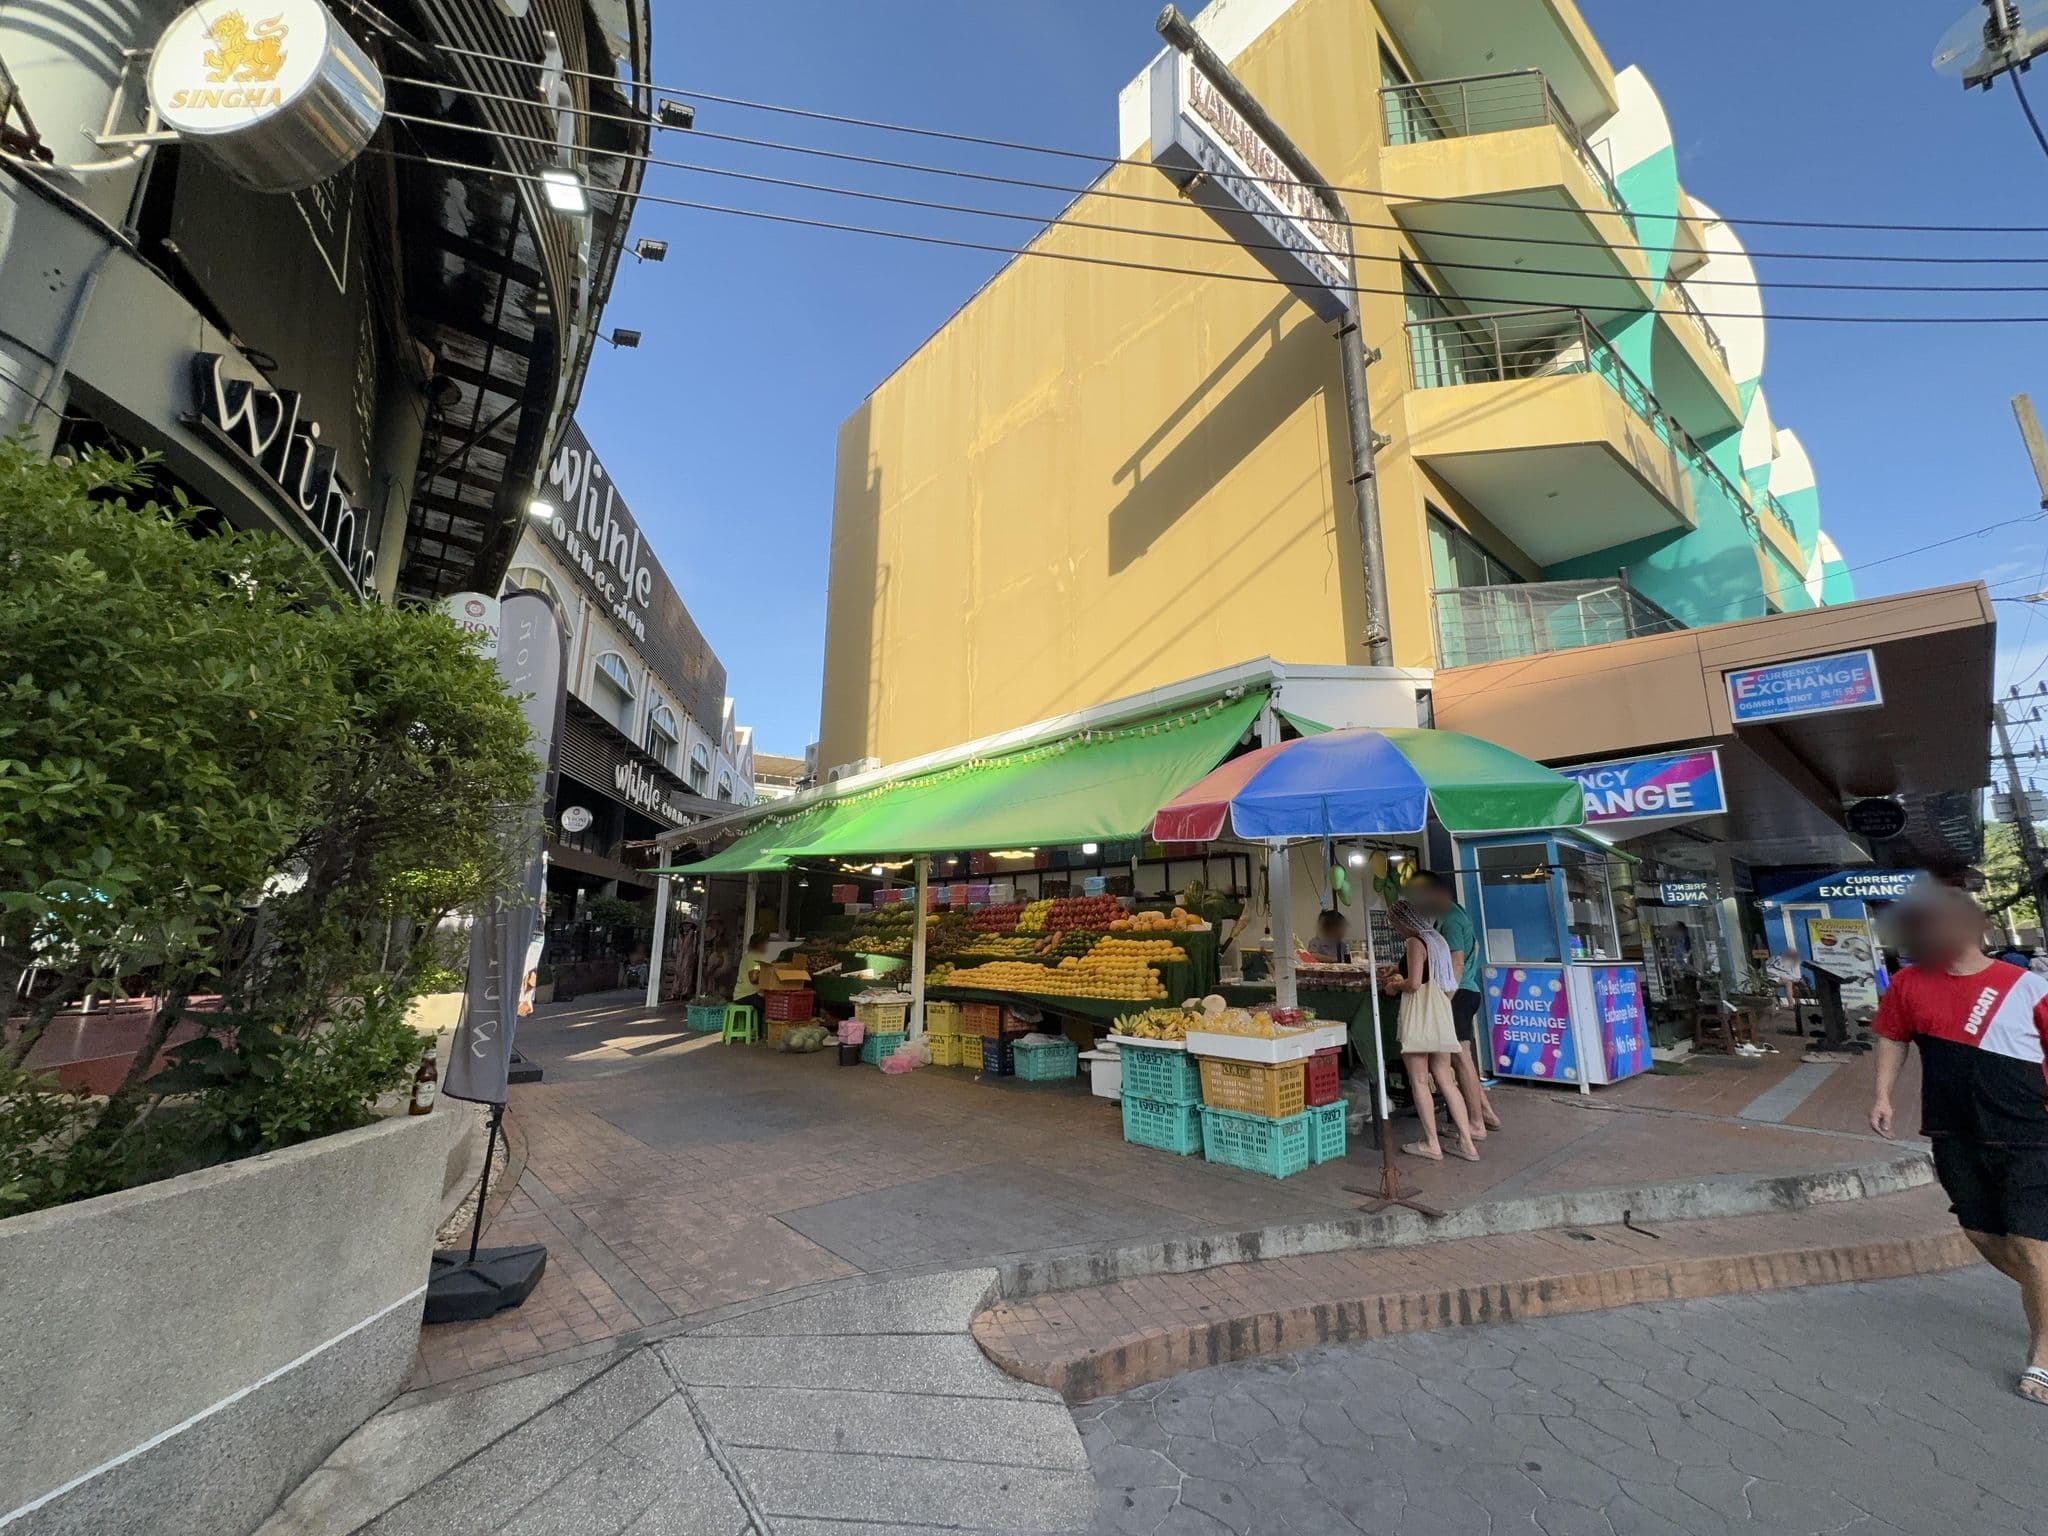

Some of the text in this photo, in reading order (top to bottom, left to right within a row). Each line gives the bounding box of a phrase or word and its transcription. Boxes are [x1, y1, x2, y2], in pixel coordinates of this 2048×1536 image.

[169, 88, 282, 109] SINGHA
[1736, 668, 1866, 699] EXCHANGE
[1757, 665, 1822, 682] CURRENCY
[1578, 768, 1630, 790] NCY
[1584, 781, 1695, 816] ANGE
[1846, 874, 1916, 884] CURRENCY
[1502, 999, 1553, 1012] MONEY
[1963, 986, 1999, 1035] DUCATI
[1494, 1014, 1567, 1029] EXCHANGE
[1503, 1031, 1561, 1045] SERVICE
[1615, 1034, 1638, 1055] No Fee
